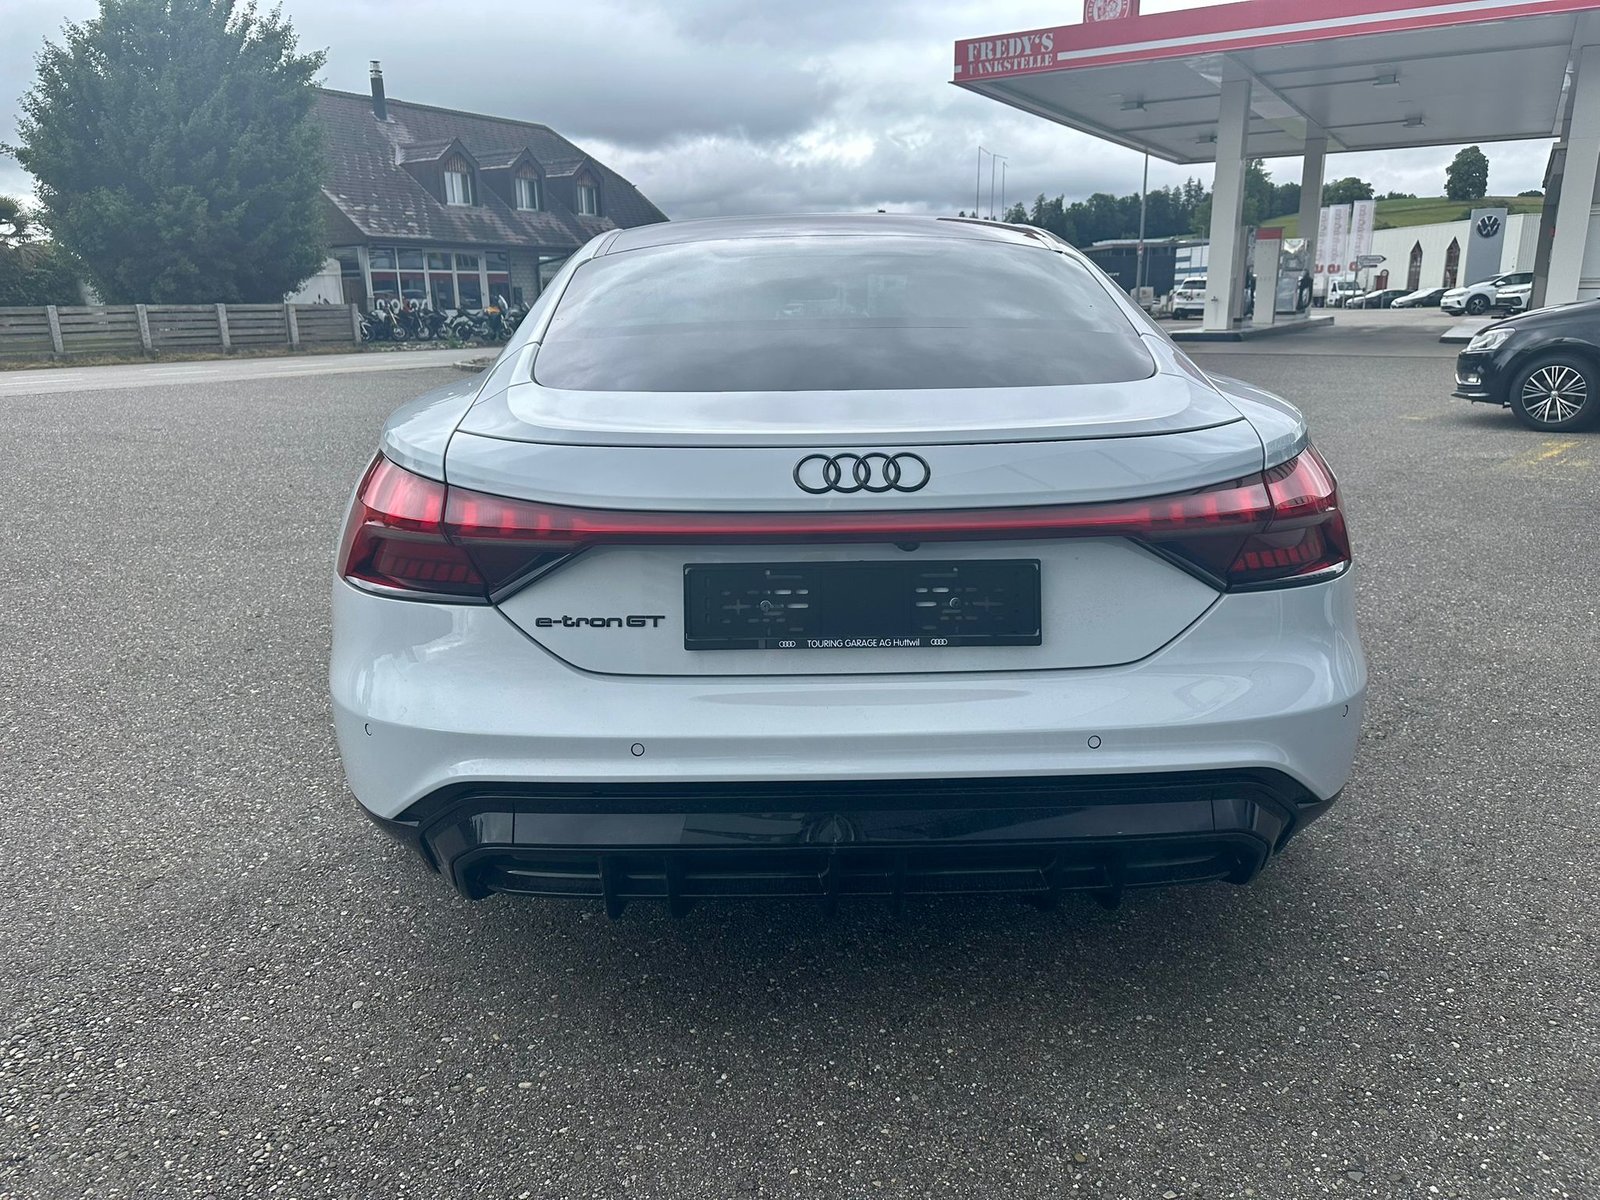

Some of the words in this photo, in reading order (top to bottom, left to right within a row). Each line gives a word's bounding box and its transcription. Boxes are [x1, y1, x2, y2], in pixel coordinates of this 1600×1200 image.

[968, 53, 1053, 75] TANKSTELLE
[535, 615, 622, 628] e-tron
[626, 615, 666, 628] GT
[807, 639, 843, 648] TOURING
[845, 639, 878, 647] GARAGE
[879, 638, 892, 647] AG
[893, 637, 920, 647] Huttwil
